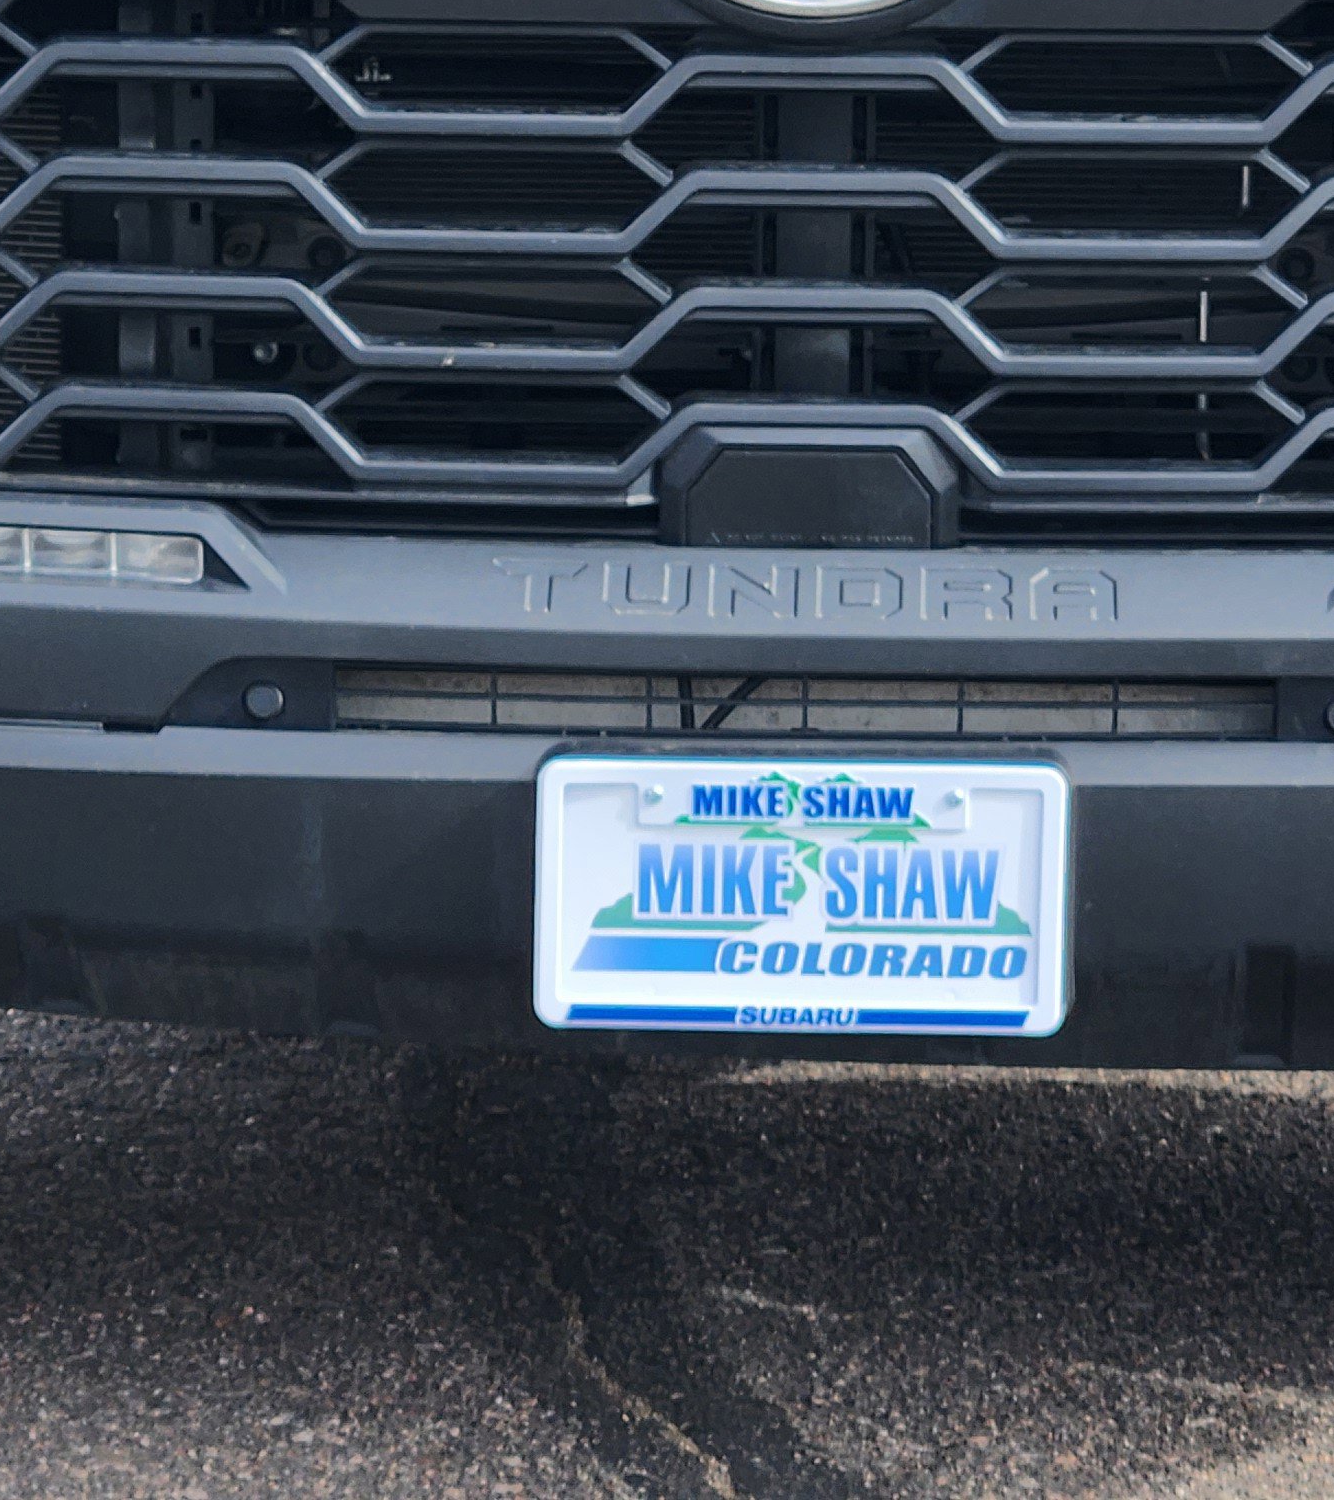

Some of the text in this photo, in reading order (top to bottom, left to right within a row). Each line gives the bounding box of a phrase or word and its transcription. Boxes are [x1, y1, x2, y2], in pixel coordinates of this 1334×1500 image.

[492, 557, 1119, 621] TUNDRA
[693, 784, 914, 819] MIKE SHAW
[638, 844, 999, 920] MIKE SHAW
[721, 941, 1028, 979] COLORADO
[741, 1006, 854, 1026] SUBARU
